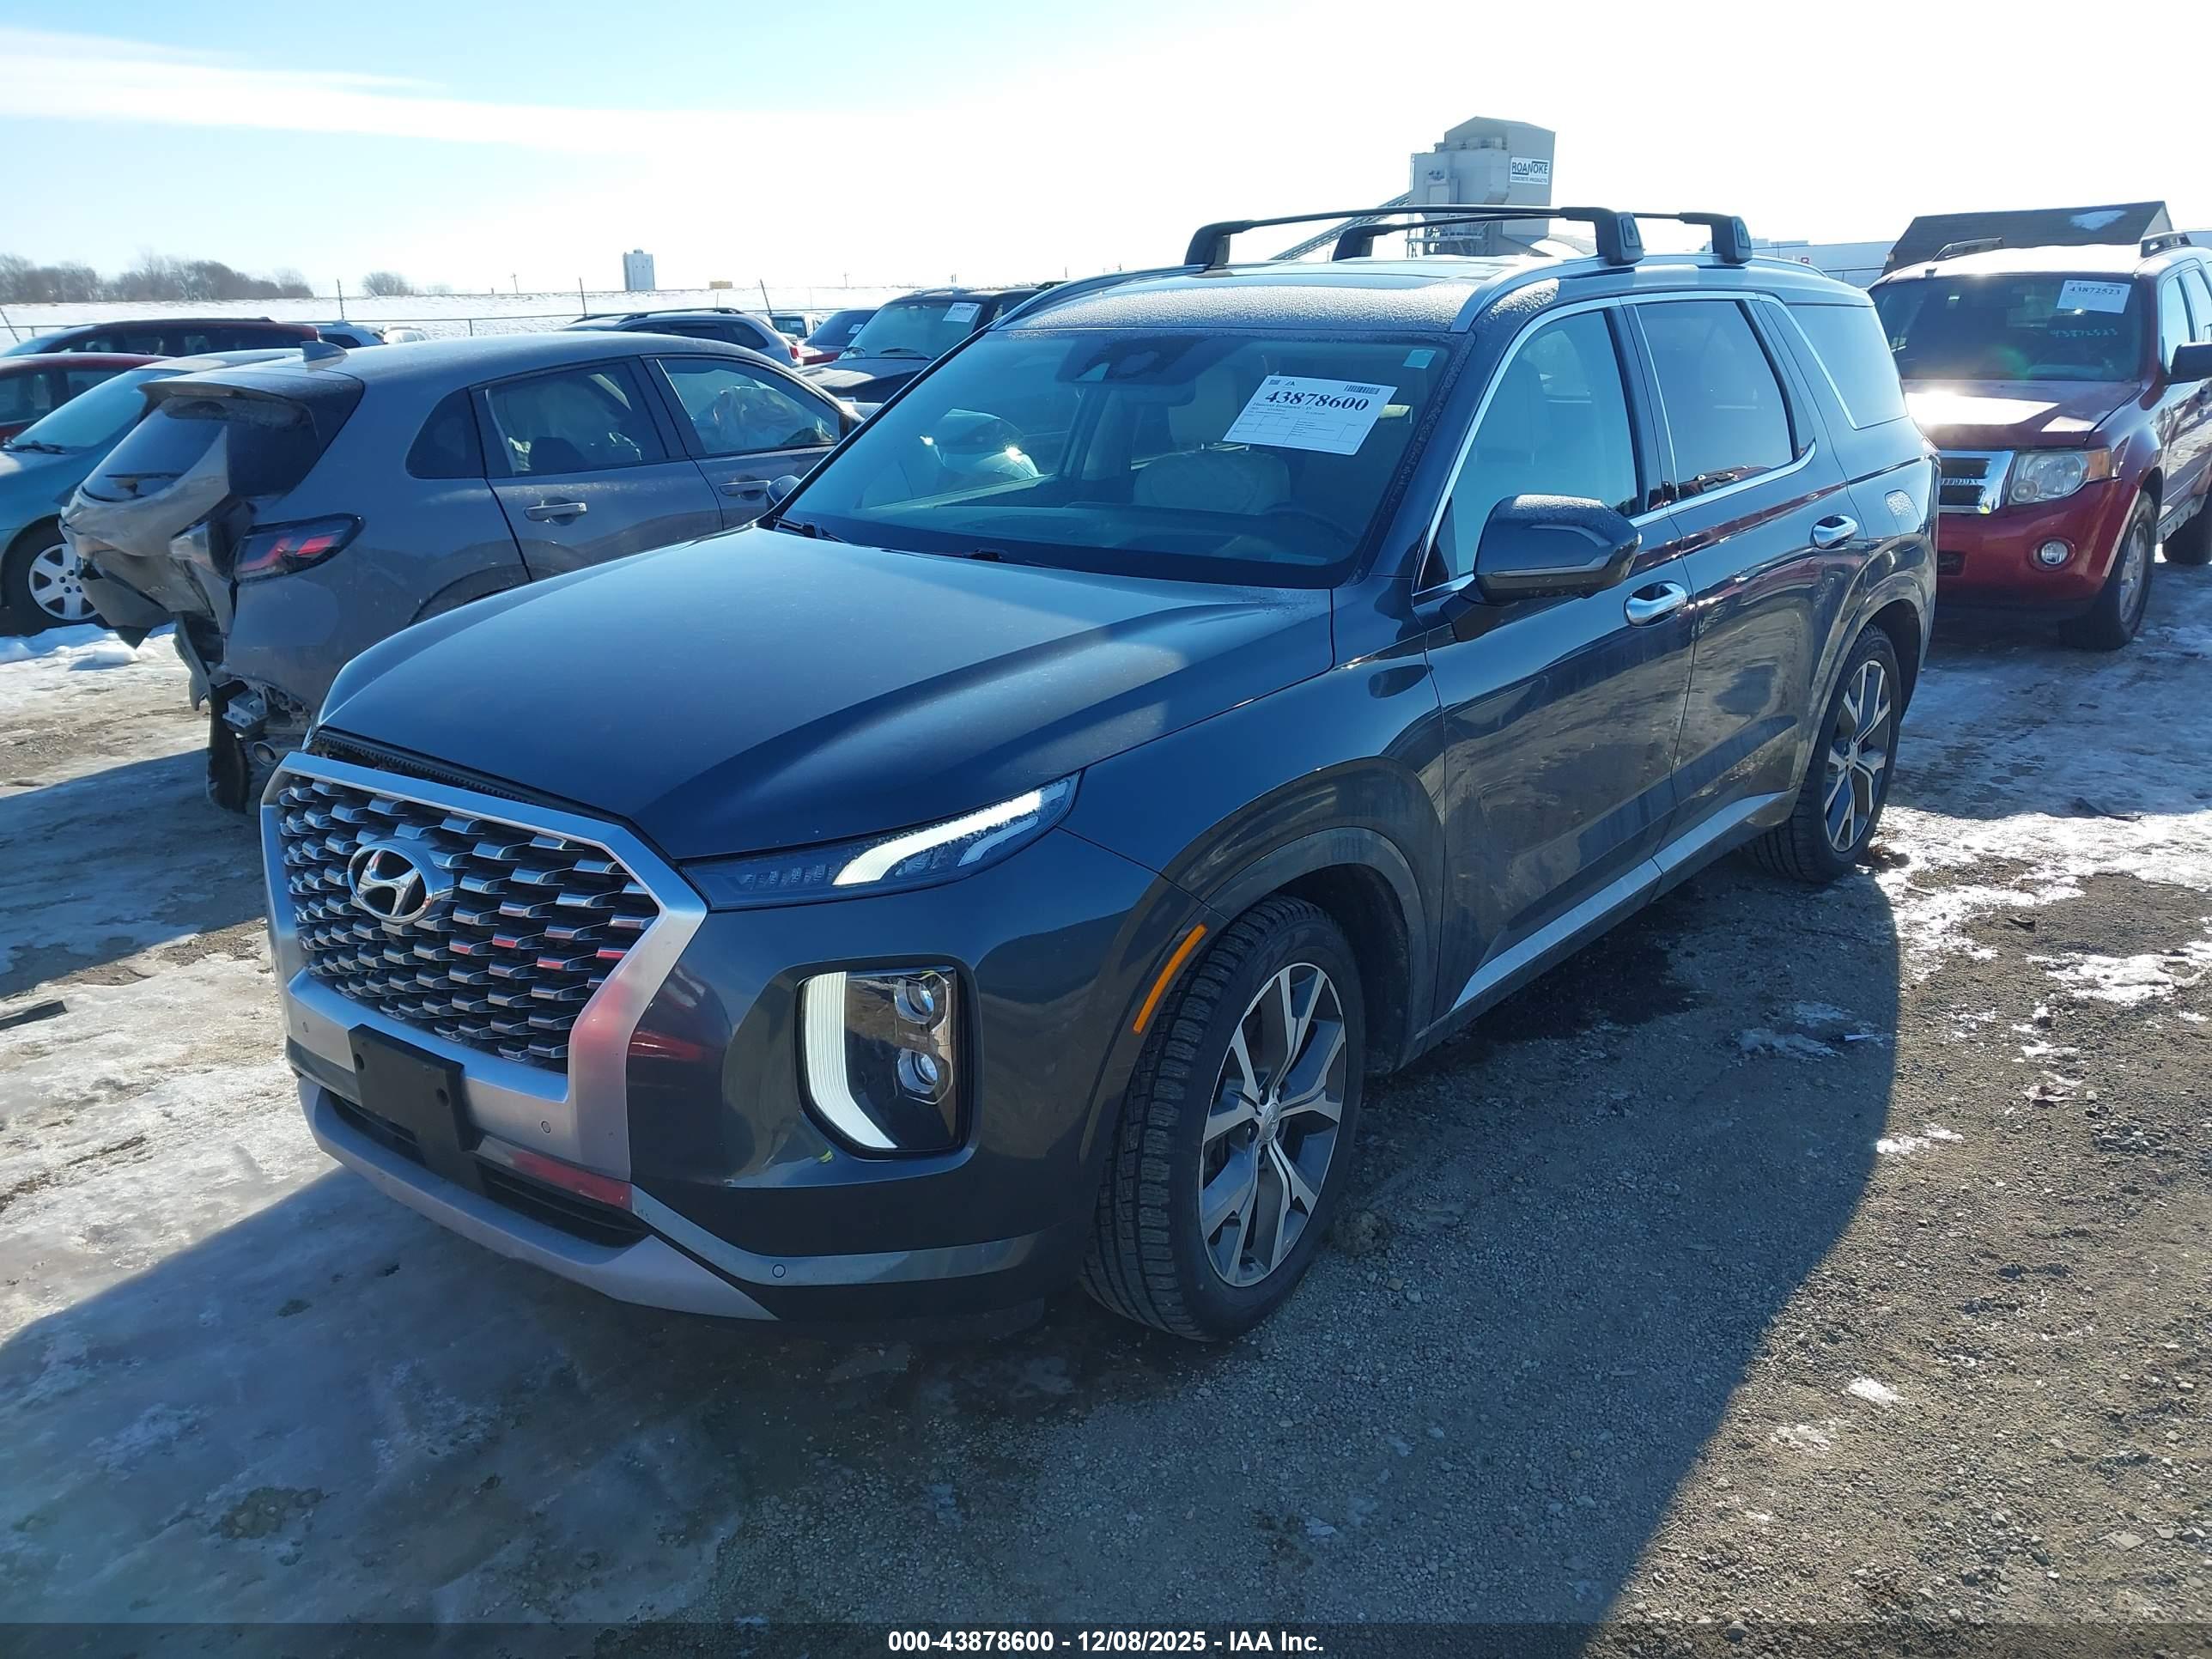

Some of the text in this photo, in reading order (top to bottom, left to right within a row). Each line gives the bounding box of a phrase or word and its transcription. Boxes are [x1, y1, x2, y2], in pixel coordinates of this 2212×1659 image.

[1511, 161, 1548, 174] ROANOKE
[2069, 286, 2121, 296] 43872523
[1265, 391, 1370, 411] 43878600
